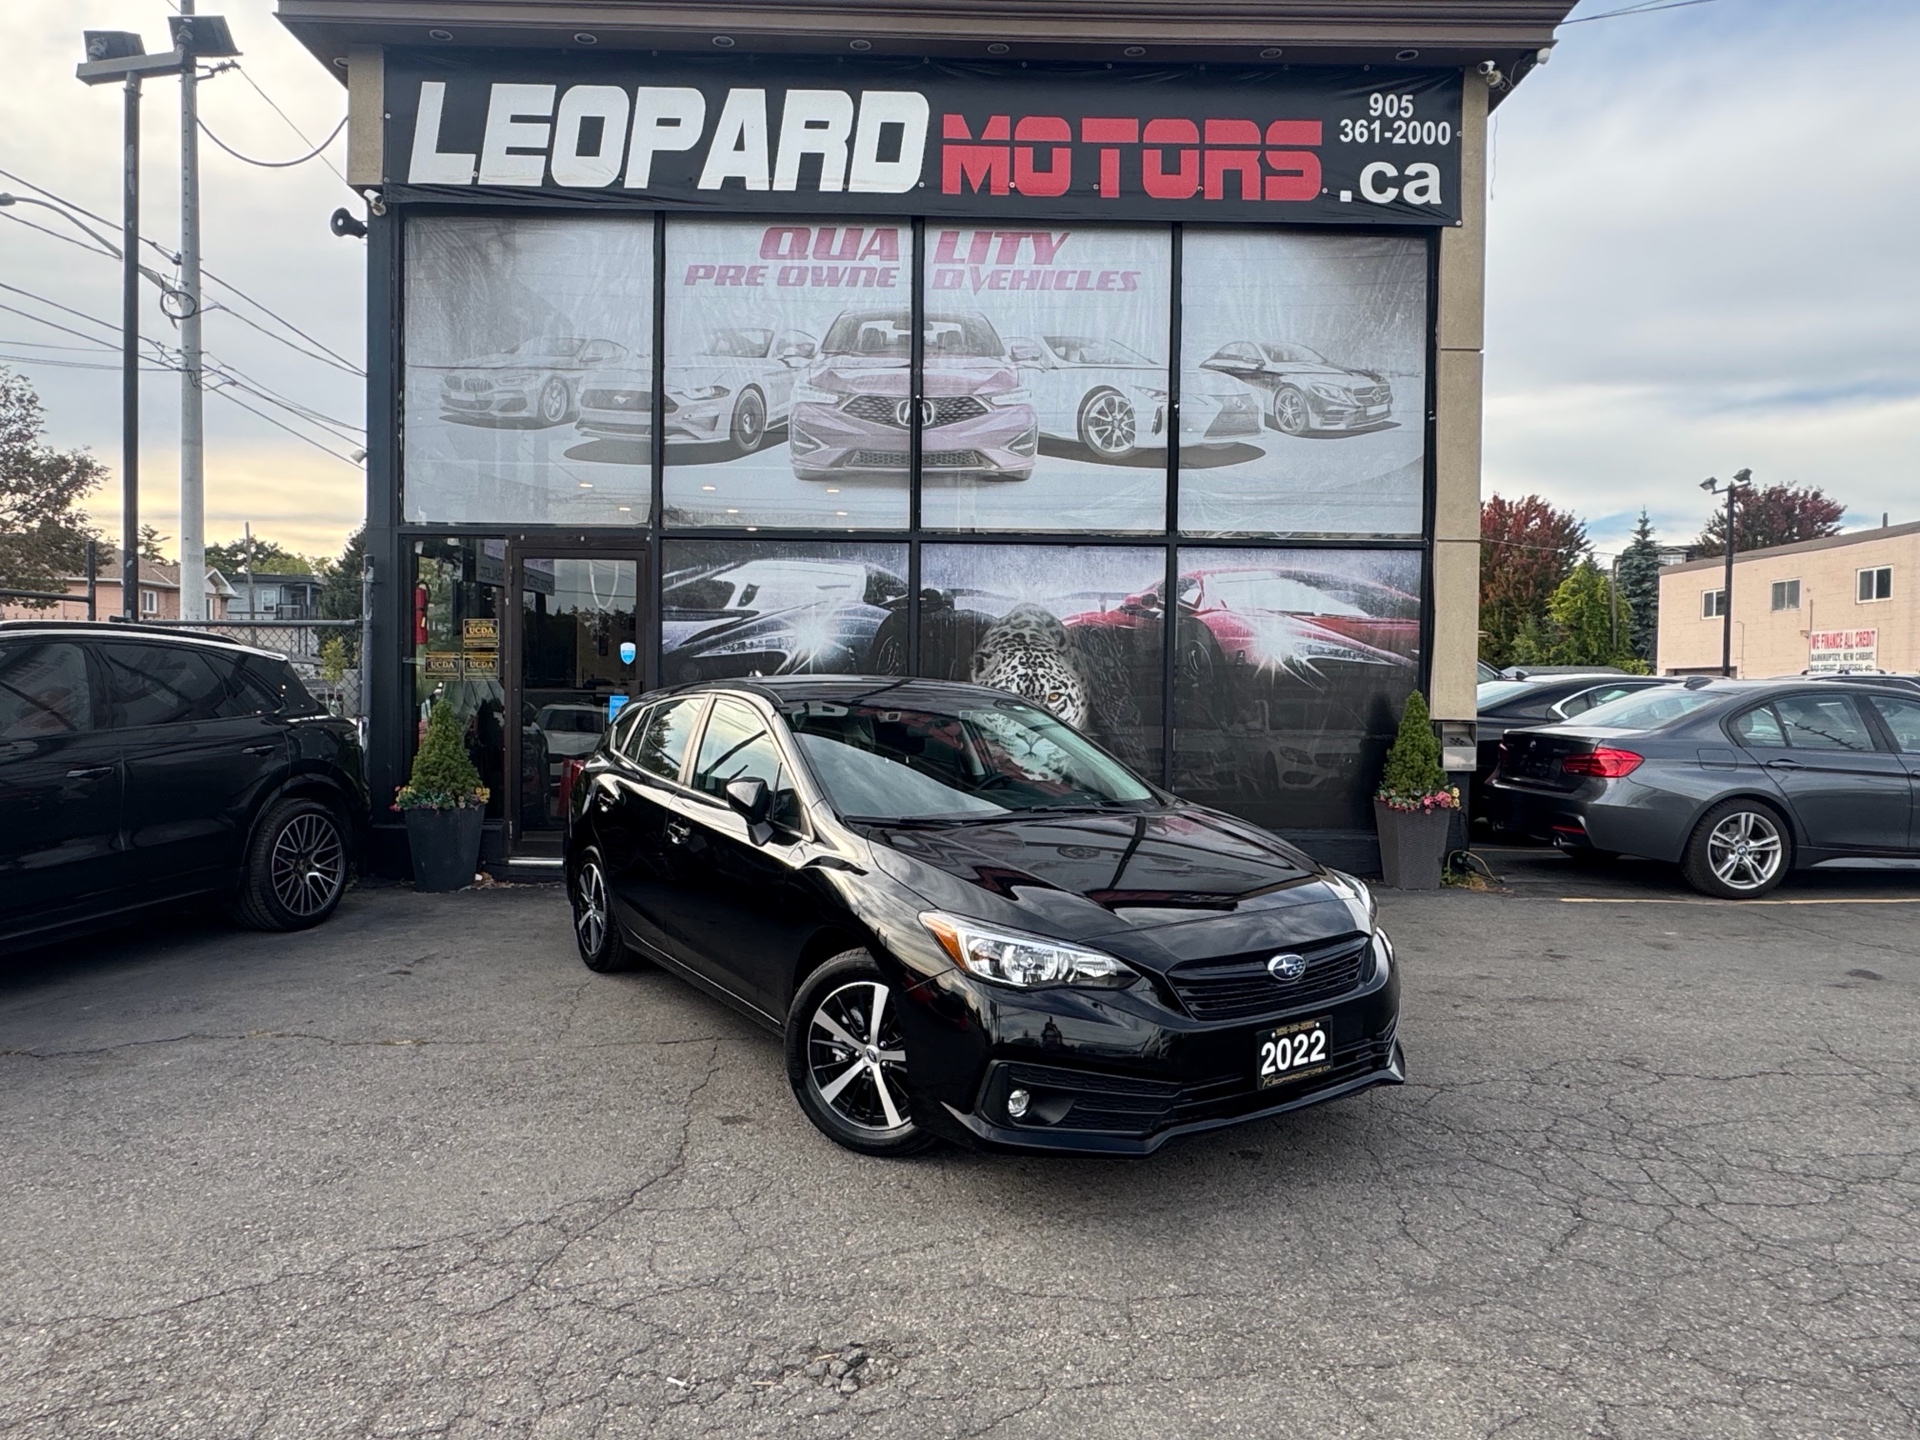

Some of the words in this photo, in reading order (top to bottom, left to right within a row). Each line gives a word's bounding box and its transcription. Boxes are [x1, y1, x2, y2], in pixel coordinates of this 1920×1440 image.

[1369, 93, 1414, 118] 905
[408, 81, 930, 193] LEOPARD
[942, 113, 1323, 201] MOTORS
[1340, 119, 1451, 145] 361-2000
[1340, 161, 1442, 205] .ca
[759, 227, 899, 261] QUA
[933, 231, 1070, 265] LITY
[684, 265, 769, 287] PRE
[777, 266, 900, 288] OWNE
[468, 626, 494, 634] UCDA
[1811, 634, 1820, 649] WE
[1821, 632, 1843, 649] FINANCE
[1844, 632, 1854, 649] ALL
[1855, 630, 1875, 648] CREDIT
[430, 661, 455, 669] UCDA
[1843, 652, 1854, 661] NEW
[1261, 1029, 1326, 1076] 2022
